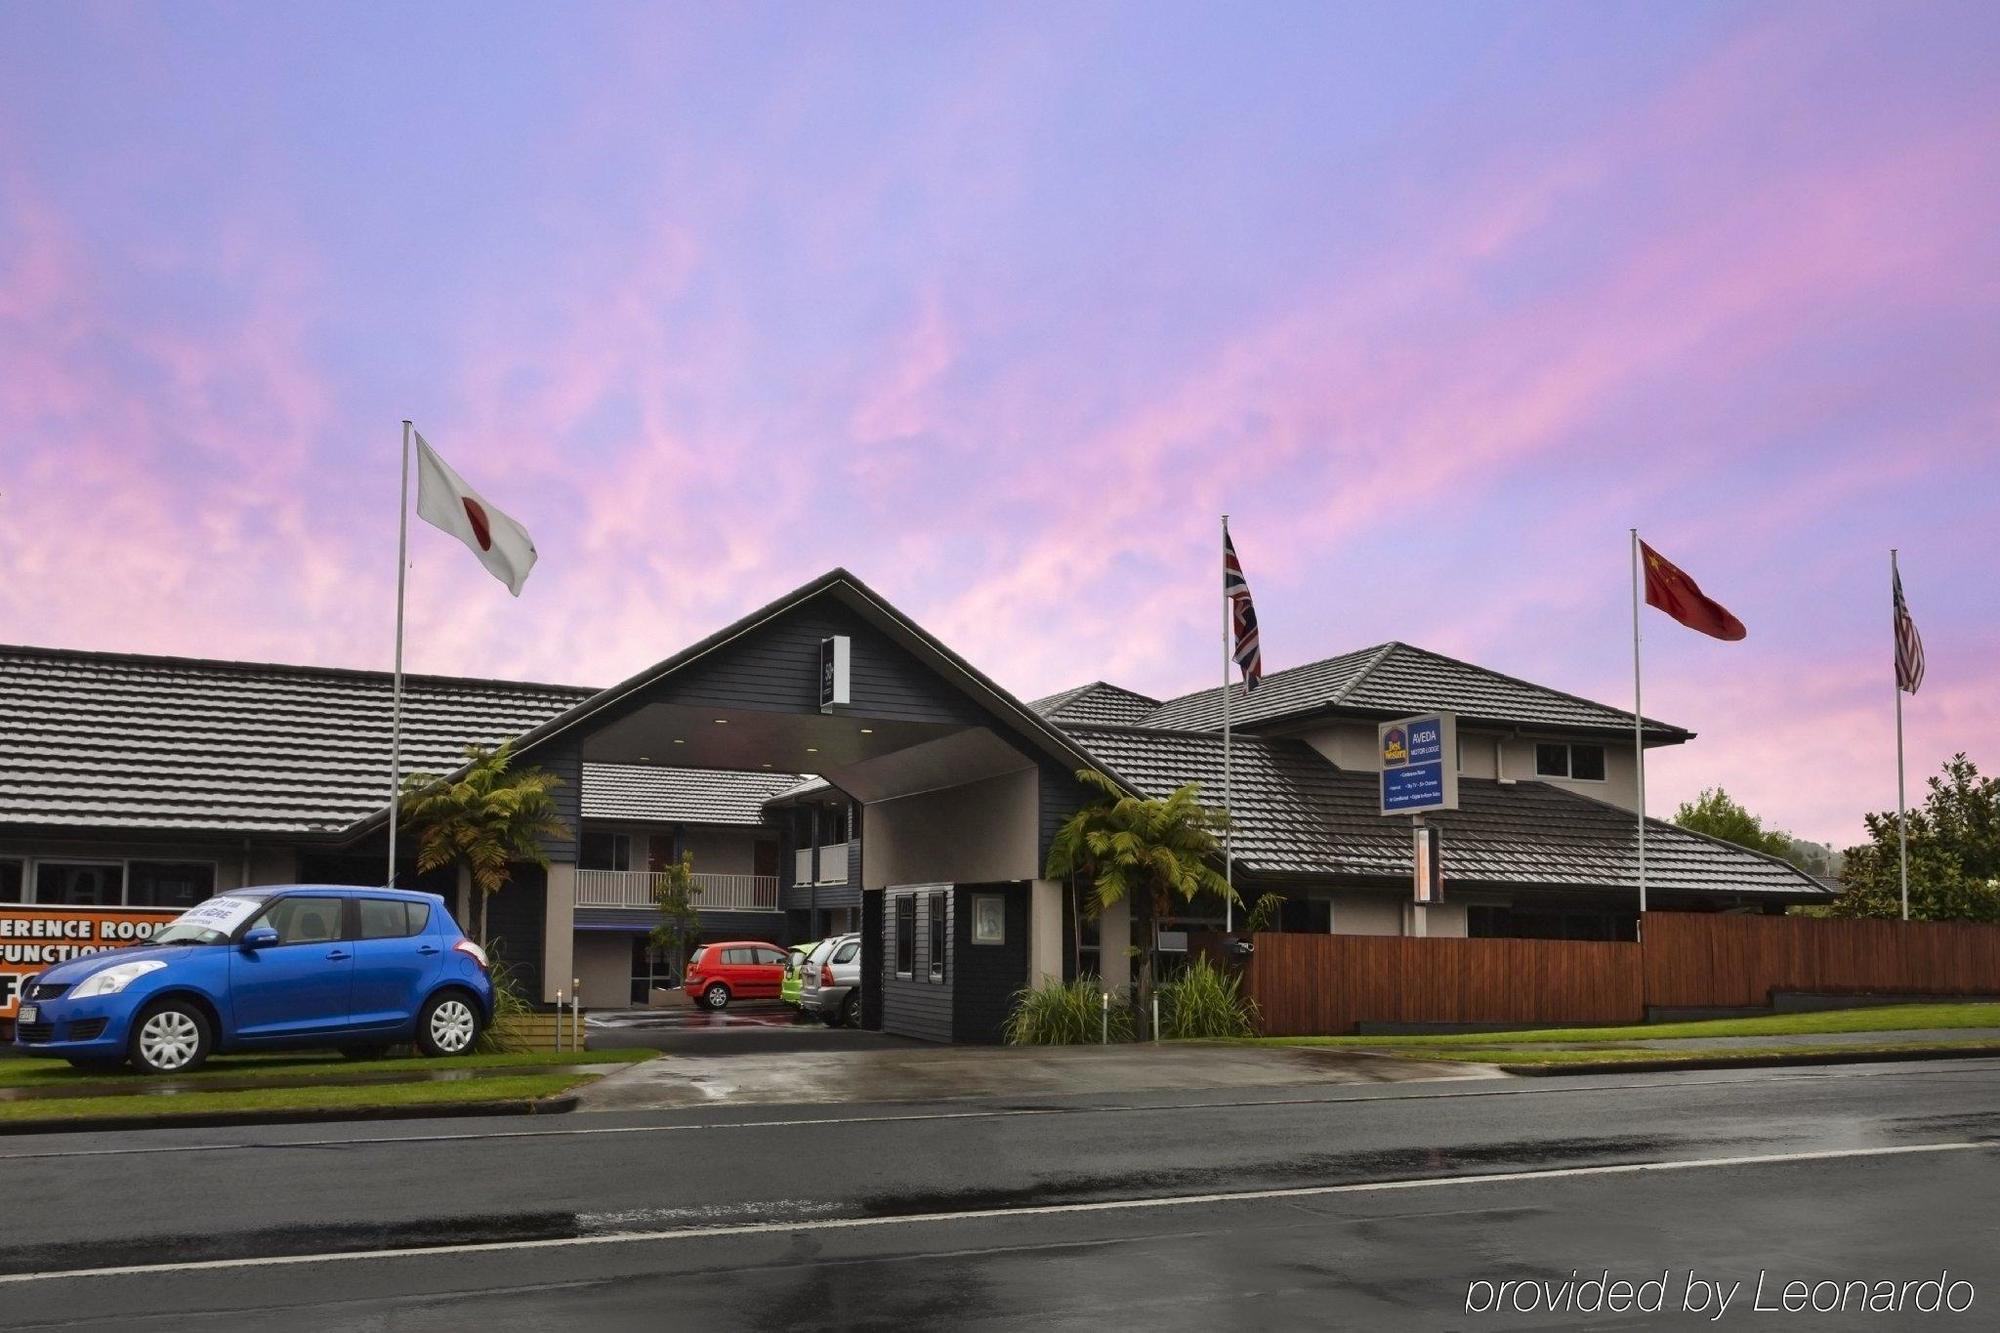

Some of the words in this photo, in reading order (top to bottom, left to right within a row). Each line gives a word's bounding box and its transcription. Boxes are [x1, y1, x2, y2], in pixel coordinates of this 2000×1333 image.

[1412, 731, 1436, 744] AVEDA
[1411, 748, 1425, 756] MOTOR
[1425, 745, 1440, 753] LODGE
